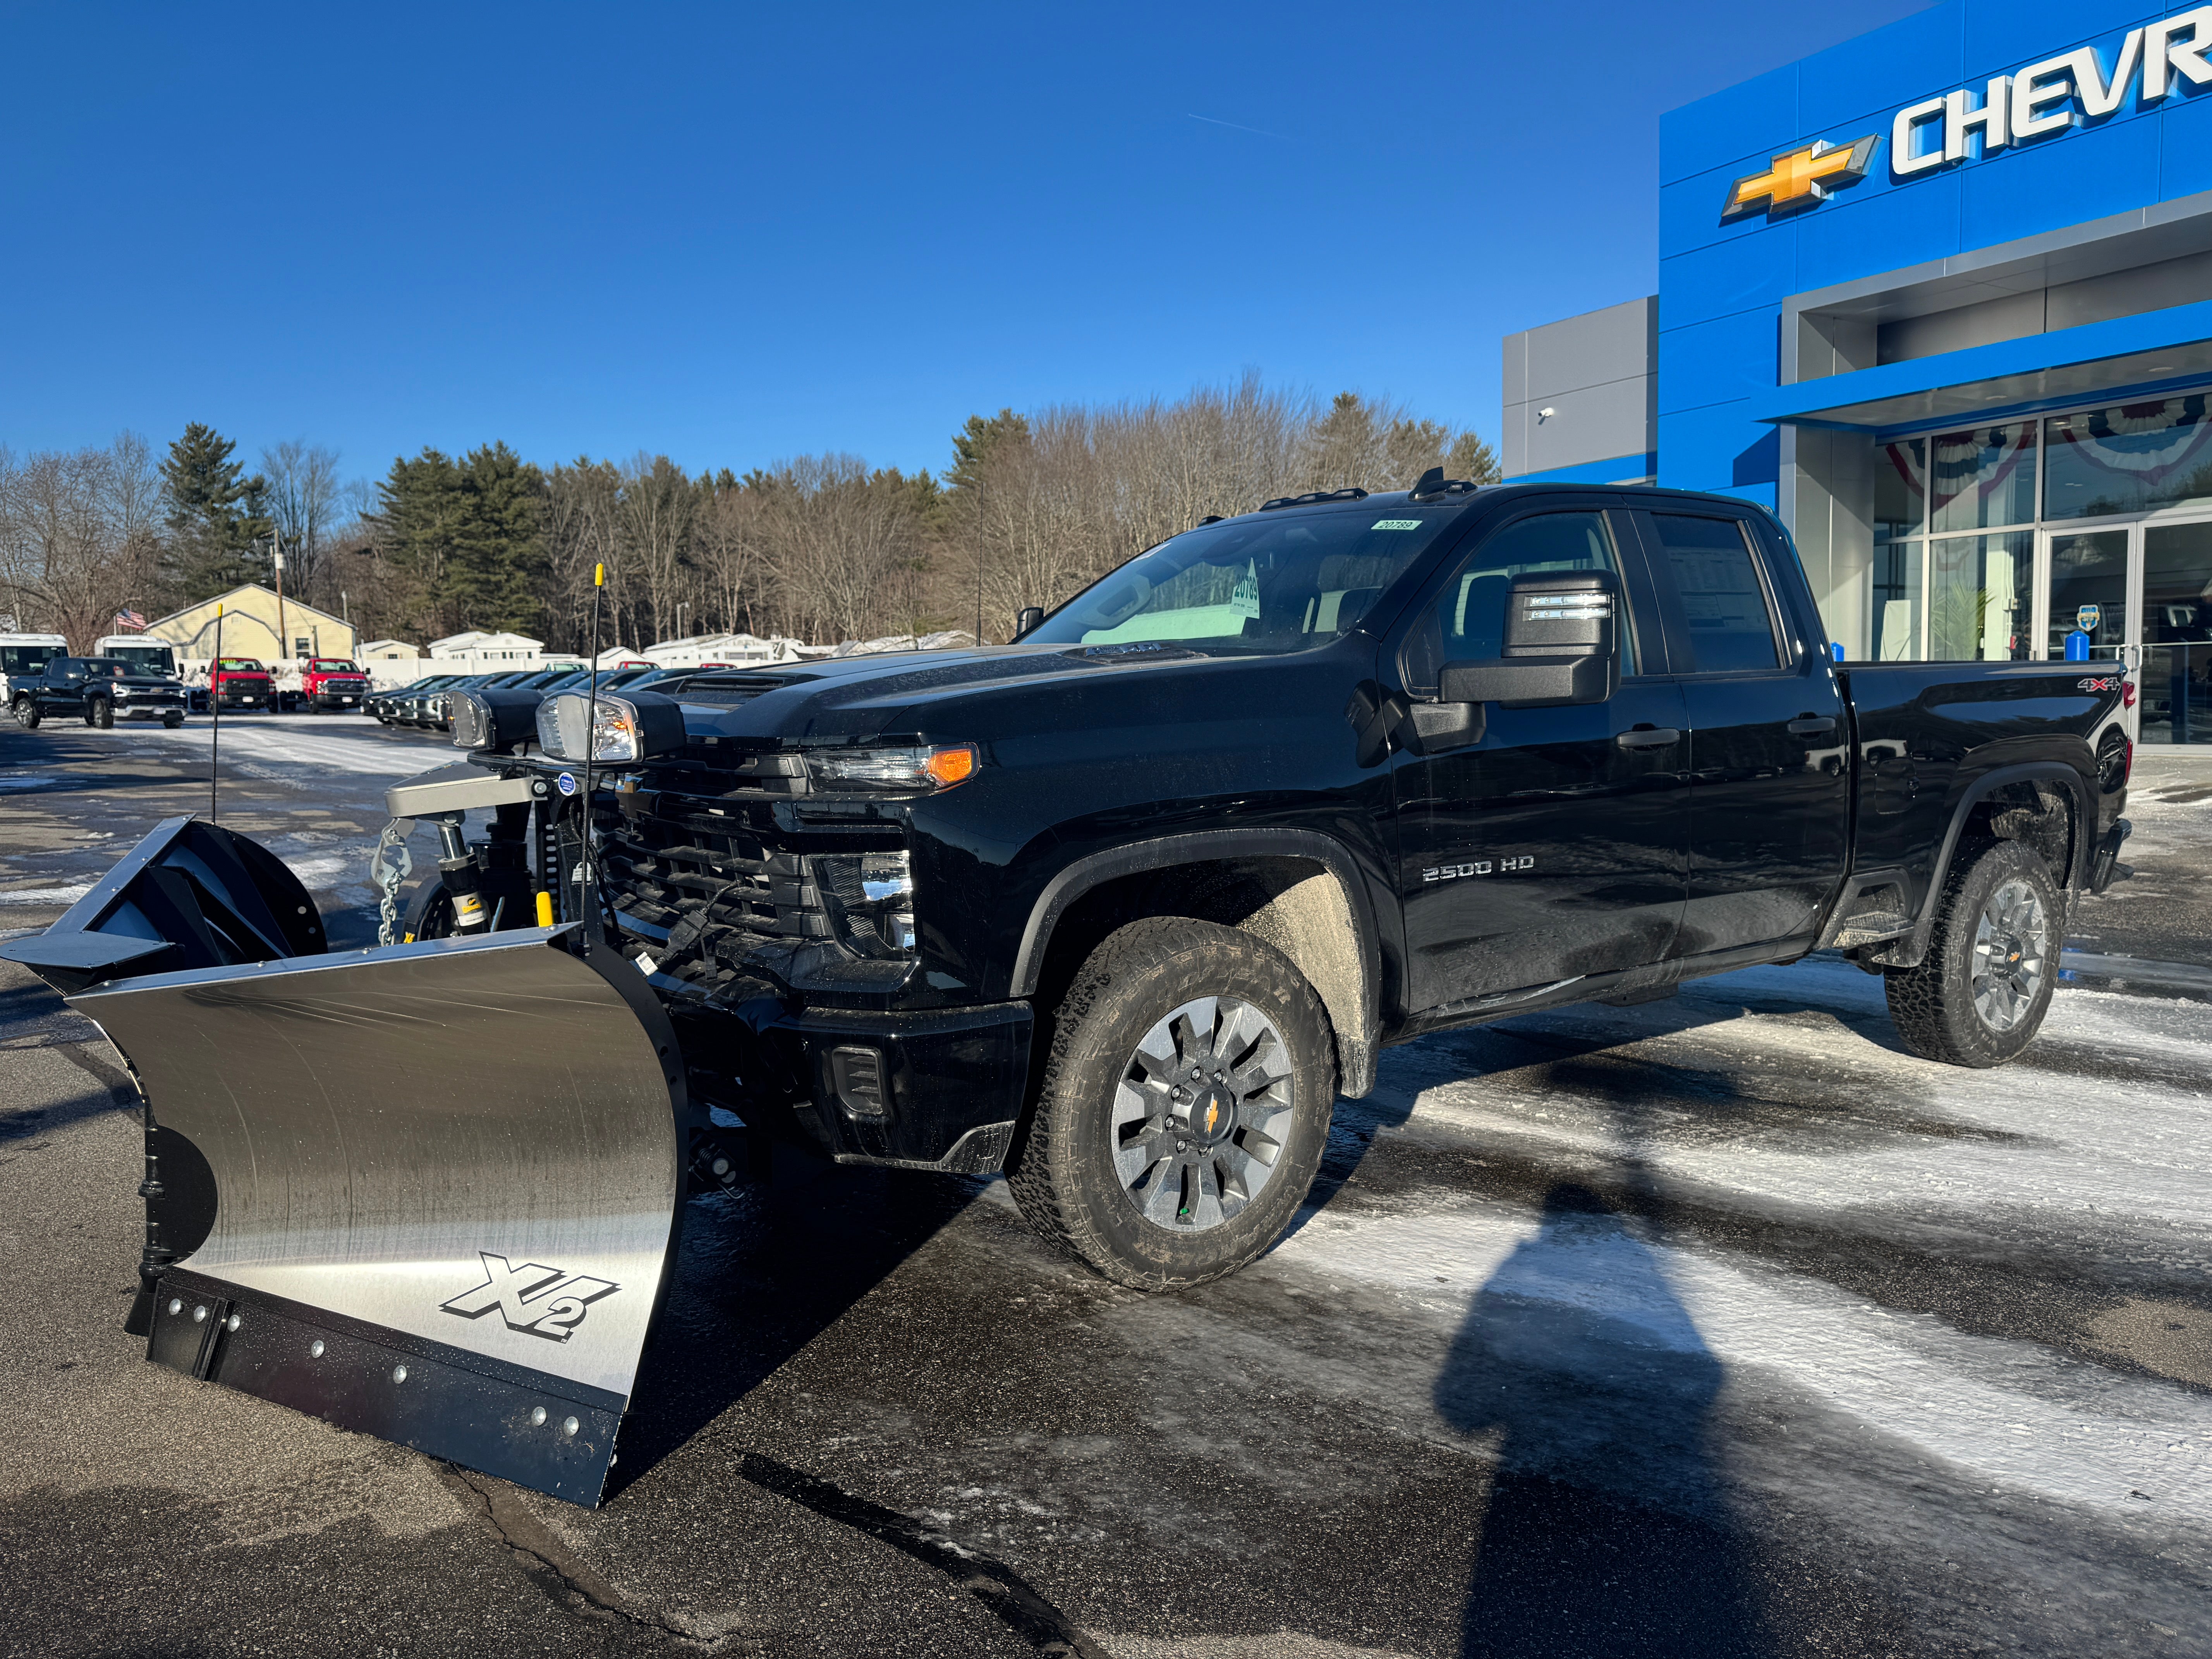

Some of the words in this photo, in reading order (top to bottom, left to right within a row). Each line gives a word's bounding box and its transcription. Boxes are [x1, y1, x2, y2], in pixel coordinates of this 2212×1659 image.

[1891, 5, 2212, 175] CHEVR
[1235, 574, 1257, 601] 20789
[1423, 860, 1492, 882] 2500
[1500, 855, 1534, 871] HD
